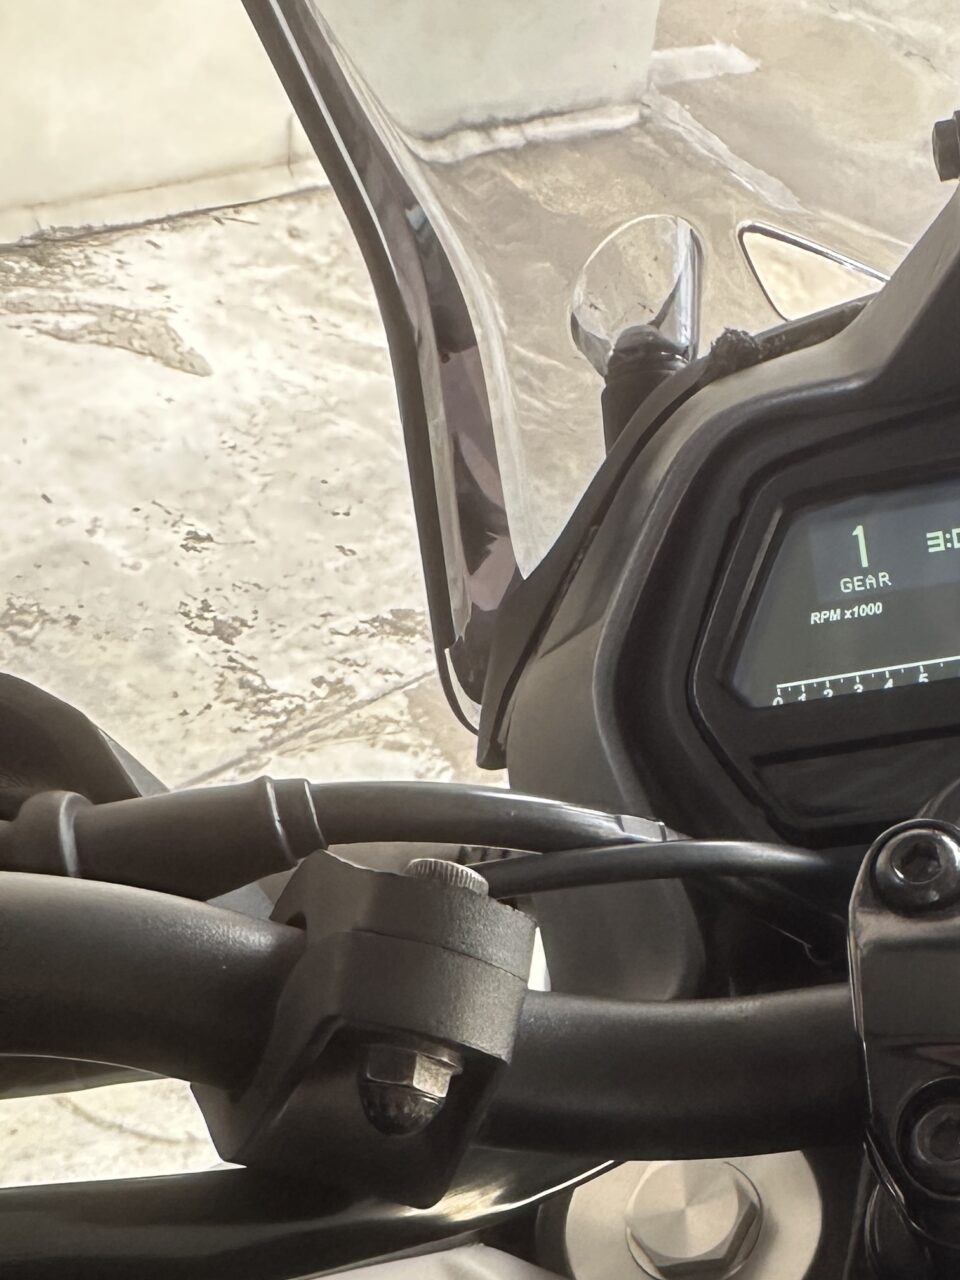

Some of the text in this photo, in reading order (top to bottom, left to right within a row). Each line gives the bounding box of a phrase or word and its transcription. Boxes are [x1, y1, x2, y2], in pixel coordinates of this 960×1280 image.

[851, 525, 869, 568] 1
[840, 571, 892, 593] GEAR
[810, 601, 883, 625] RPM x1000
